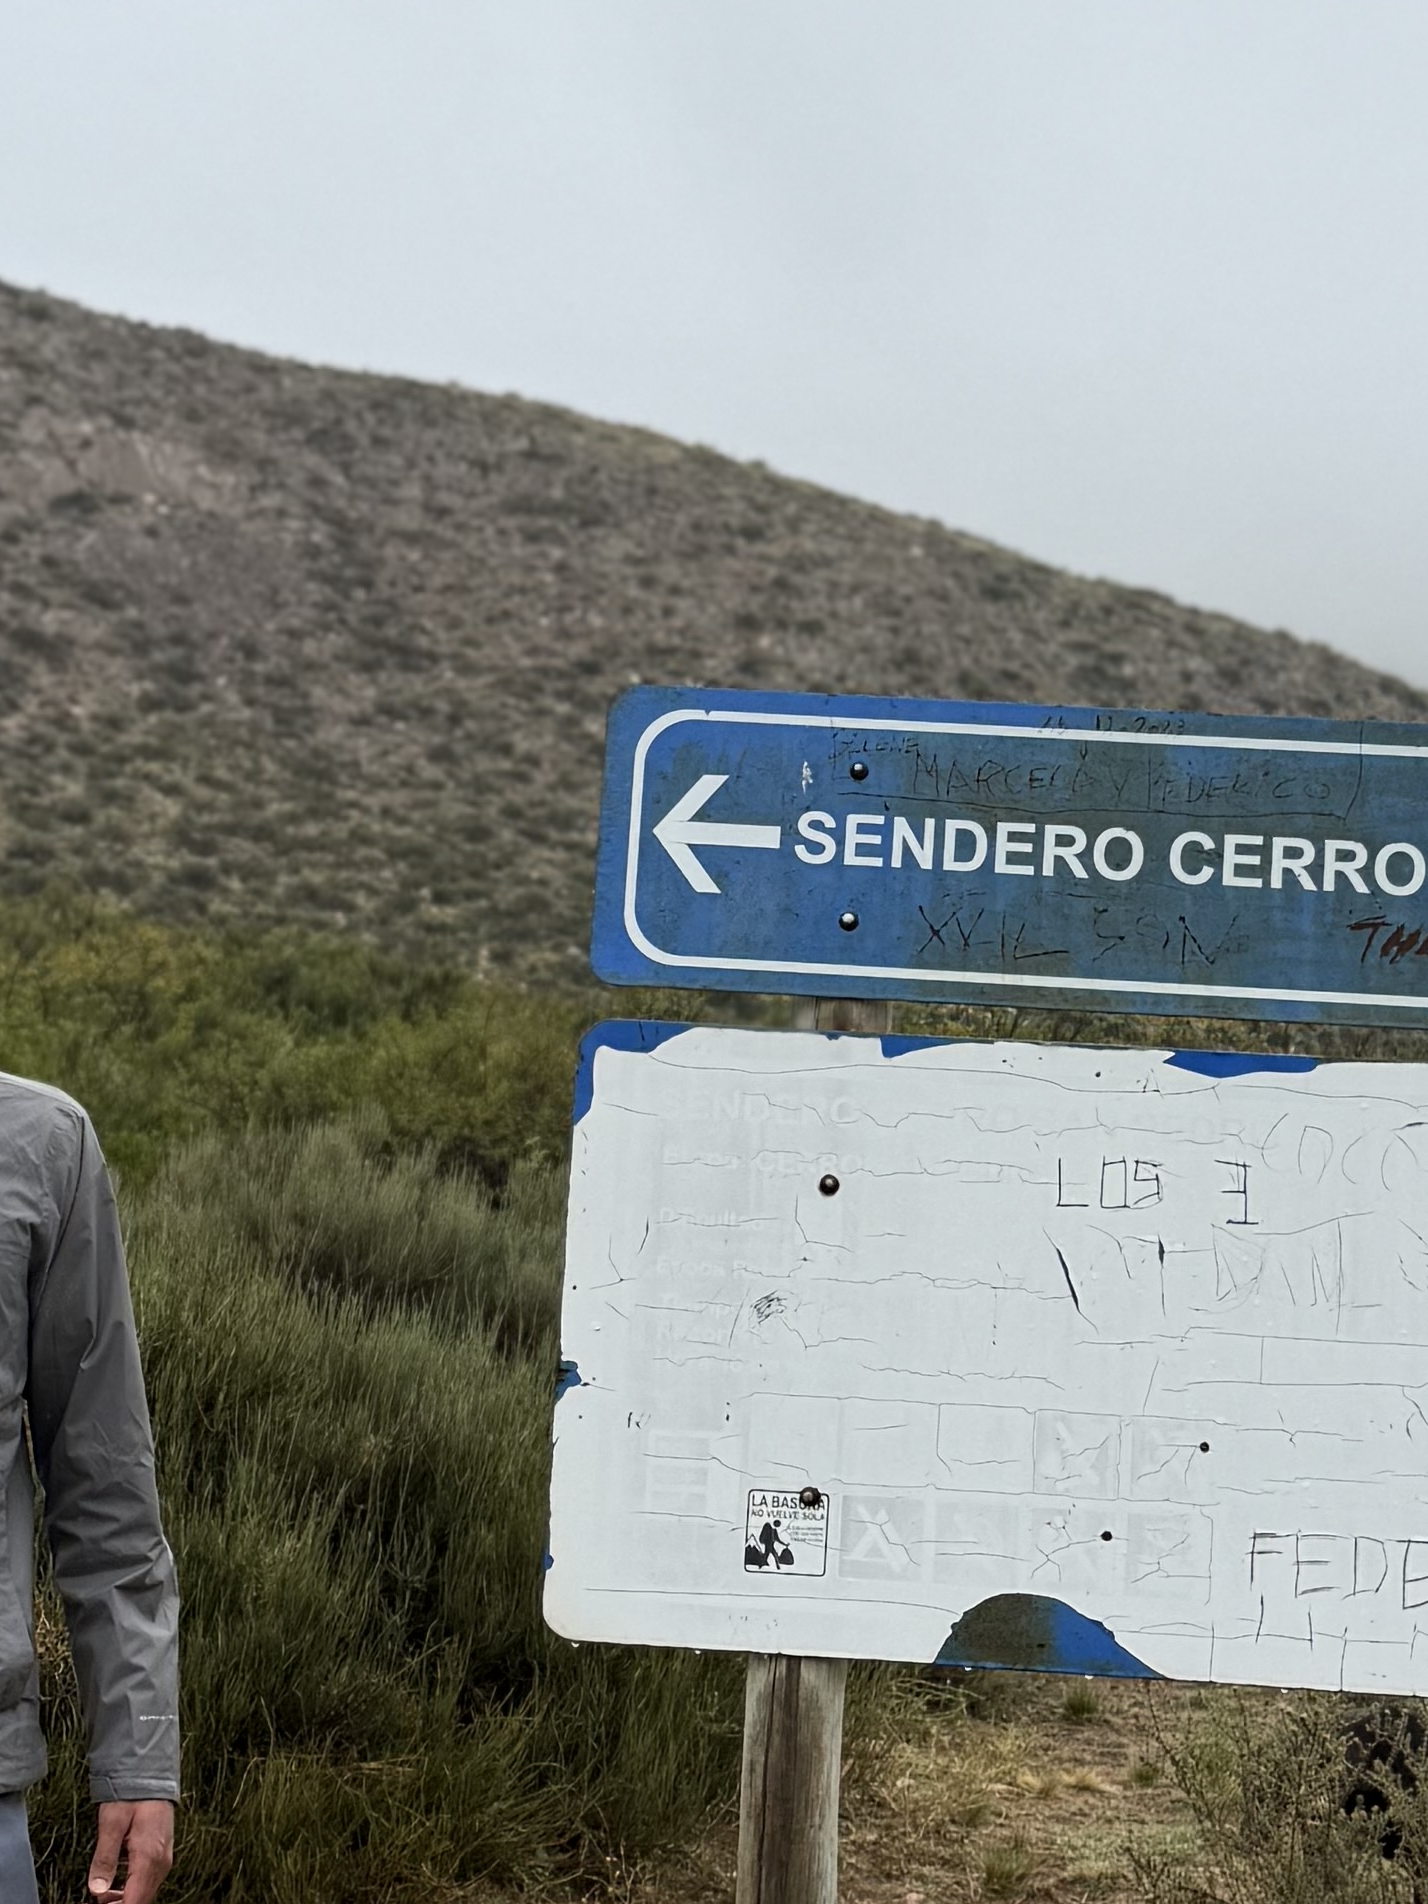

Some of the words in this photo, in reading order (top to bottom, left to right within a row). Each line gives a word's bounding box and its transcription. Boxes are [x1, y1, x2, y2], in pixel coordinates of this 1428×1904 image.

[793, 810, 1145, 882] SENDERO
[1168, 830, 1427, 897] CERRO
[1056, 1155, 1164, 1209] LOS
[751, 1509, 764, 1517] NO
[752, 1494, 768, 1507] LA
